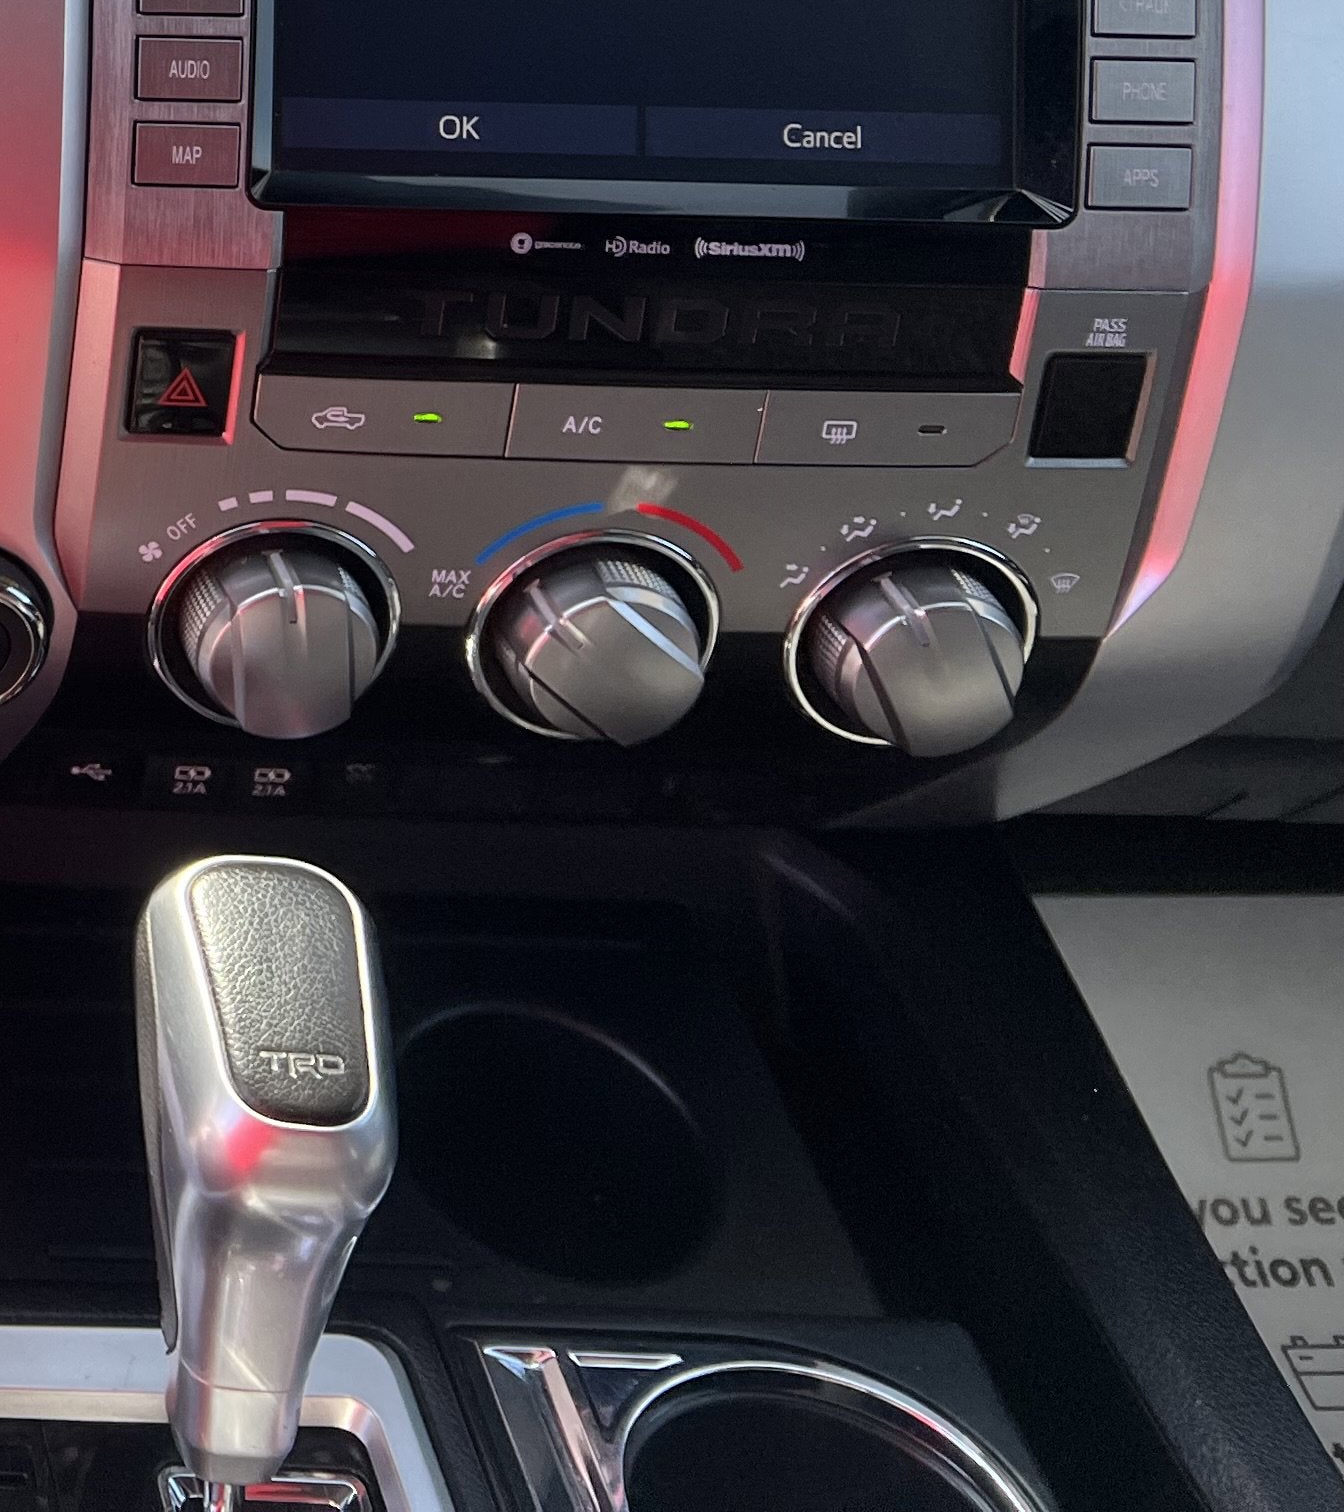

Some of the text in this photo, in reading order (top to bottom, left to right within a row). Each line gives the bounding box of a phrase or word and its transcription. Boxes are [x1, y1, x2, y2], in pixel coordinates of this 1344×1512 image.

[169, 60, 210, 80] AUDIO
[1122, 82, 1167, 101] PHONE
[438, 115, 480, 141] OK
[782, 123, 862, 150] Cancel
[171, 146, 202, 165] MAP
[1124, 169, 1159, 188] APPS
[629, 240, 670, 255] Radio
[416, 292, 902, 348] TUNDRA
[1093, 318, 1128, 332] PASS
[1086, 332, 1105, 347] AIR
[562, 416, 602, 434] A/C
[166, 513, 199, 542] OFF
[431, 569, 471, 585] MAX
[429, 584, 466, 599] A/C
[258, 1049, 346, 1080] TRD
